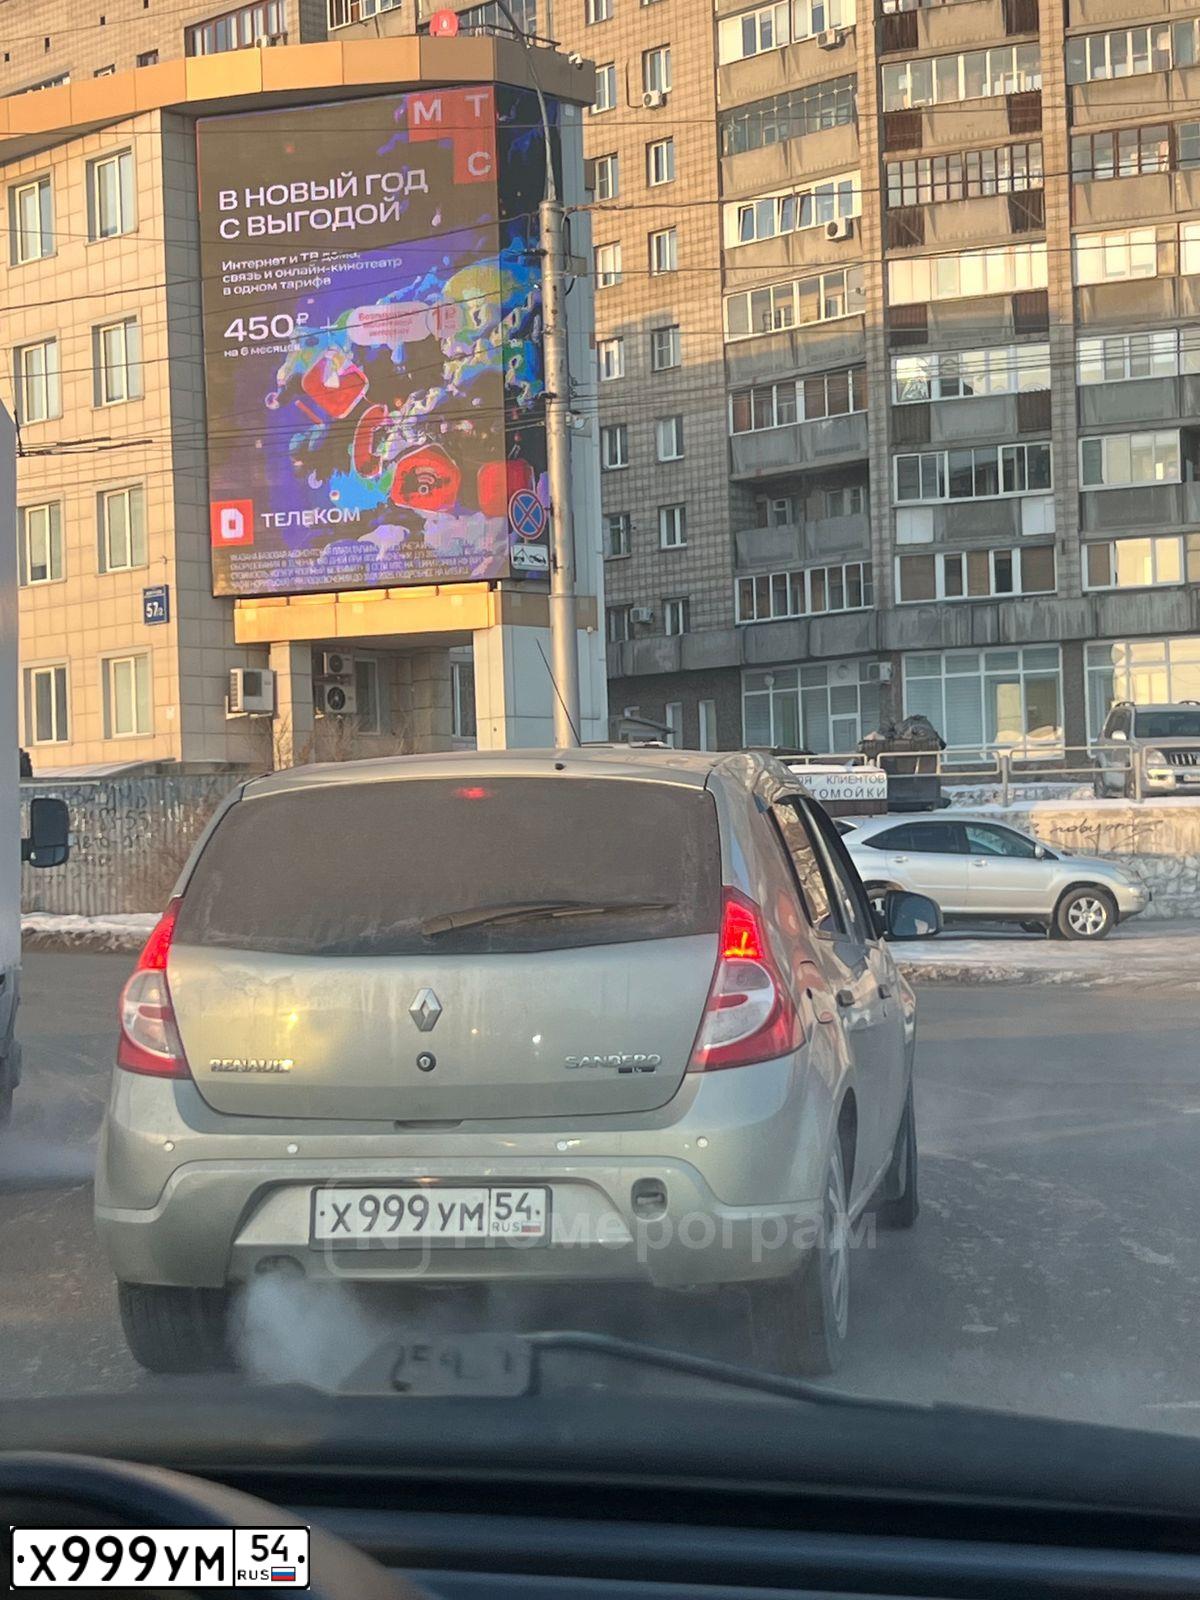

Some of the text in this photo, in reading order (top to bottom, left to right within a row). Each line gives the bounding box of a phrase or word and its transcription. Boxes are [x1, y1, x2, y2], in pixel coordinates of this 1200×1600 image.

[219, 168, 429, 211] В НОВЫЙ ГОД
[219, 196, 401, 240] С ВЫГОДОЙ
[222, 257, 287, 272] Интернет
[289, 255, 299, 264] и
[222, 257, 403, 284] связь и онлайн-кинотеатр
[223, 276, 332, 296] в одном тарифе
[261, 506, 361, 529] ТЕЛЕКОМ
[826, 774, 887, 786] КЛИЕНТОВ
[811, 786, 887, 800] ТОМОЙКИ
[565, 1053, 662, 1069] SANDERO
[494, 1192, 533, 1221] 54
[492, 1222, 520, 1233] RUS
